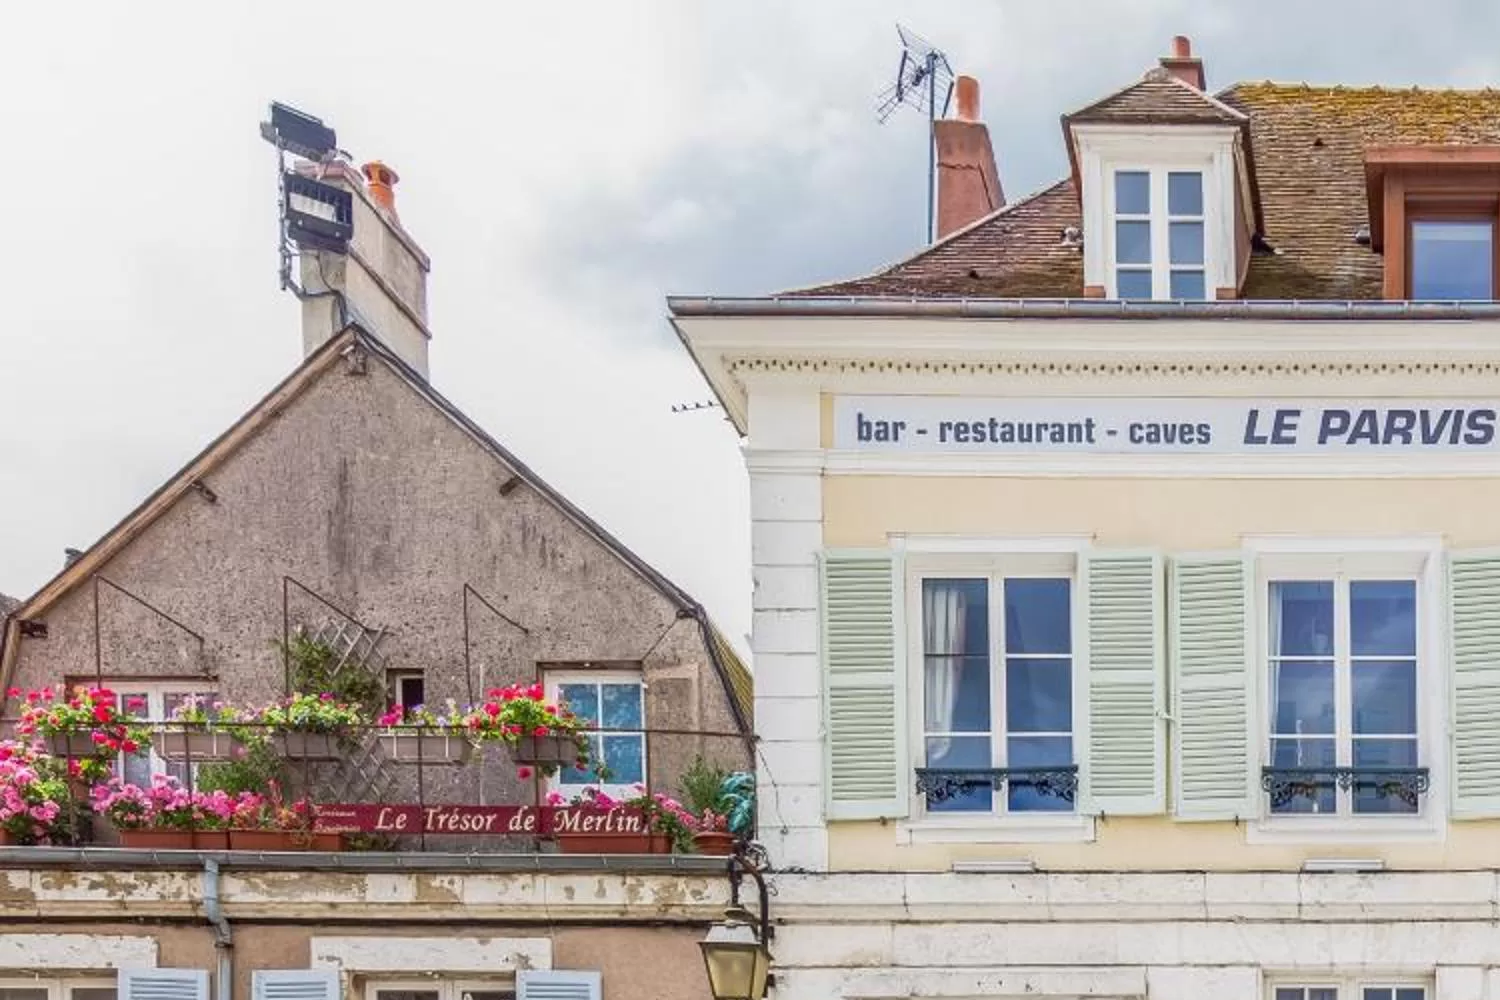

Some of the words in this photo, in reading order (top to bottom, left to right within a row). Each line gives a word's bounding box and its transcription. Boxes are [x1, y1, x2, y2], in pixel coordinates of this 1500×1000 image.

[857, 412, 906, 442] bar
[938, 417, 1096, 443] restaurant
[1128, 422, 1212, 444] caves
[1243, 408, 1301, 445] LE
[1317, 408, 1497, 445] PARVIS
[374, 807, 408, 831] Le
[421, 806, 498, 832] Trésor
[508, 805, 535, 832] de
[552, 809, 641, 832] Merlin
